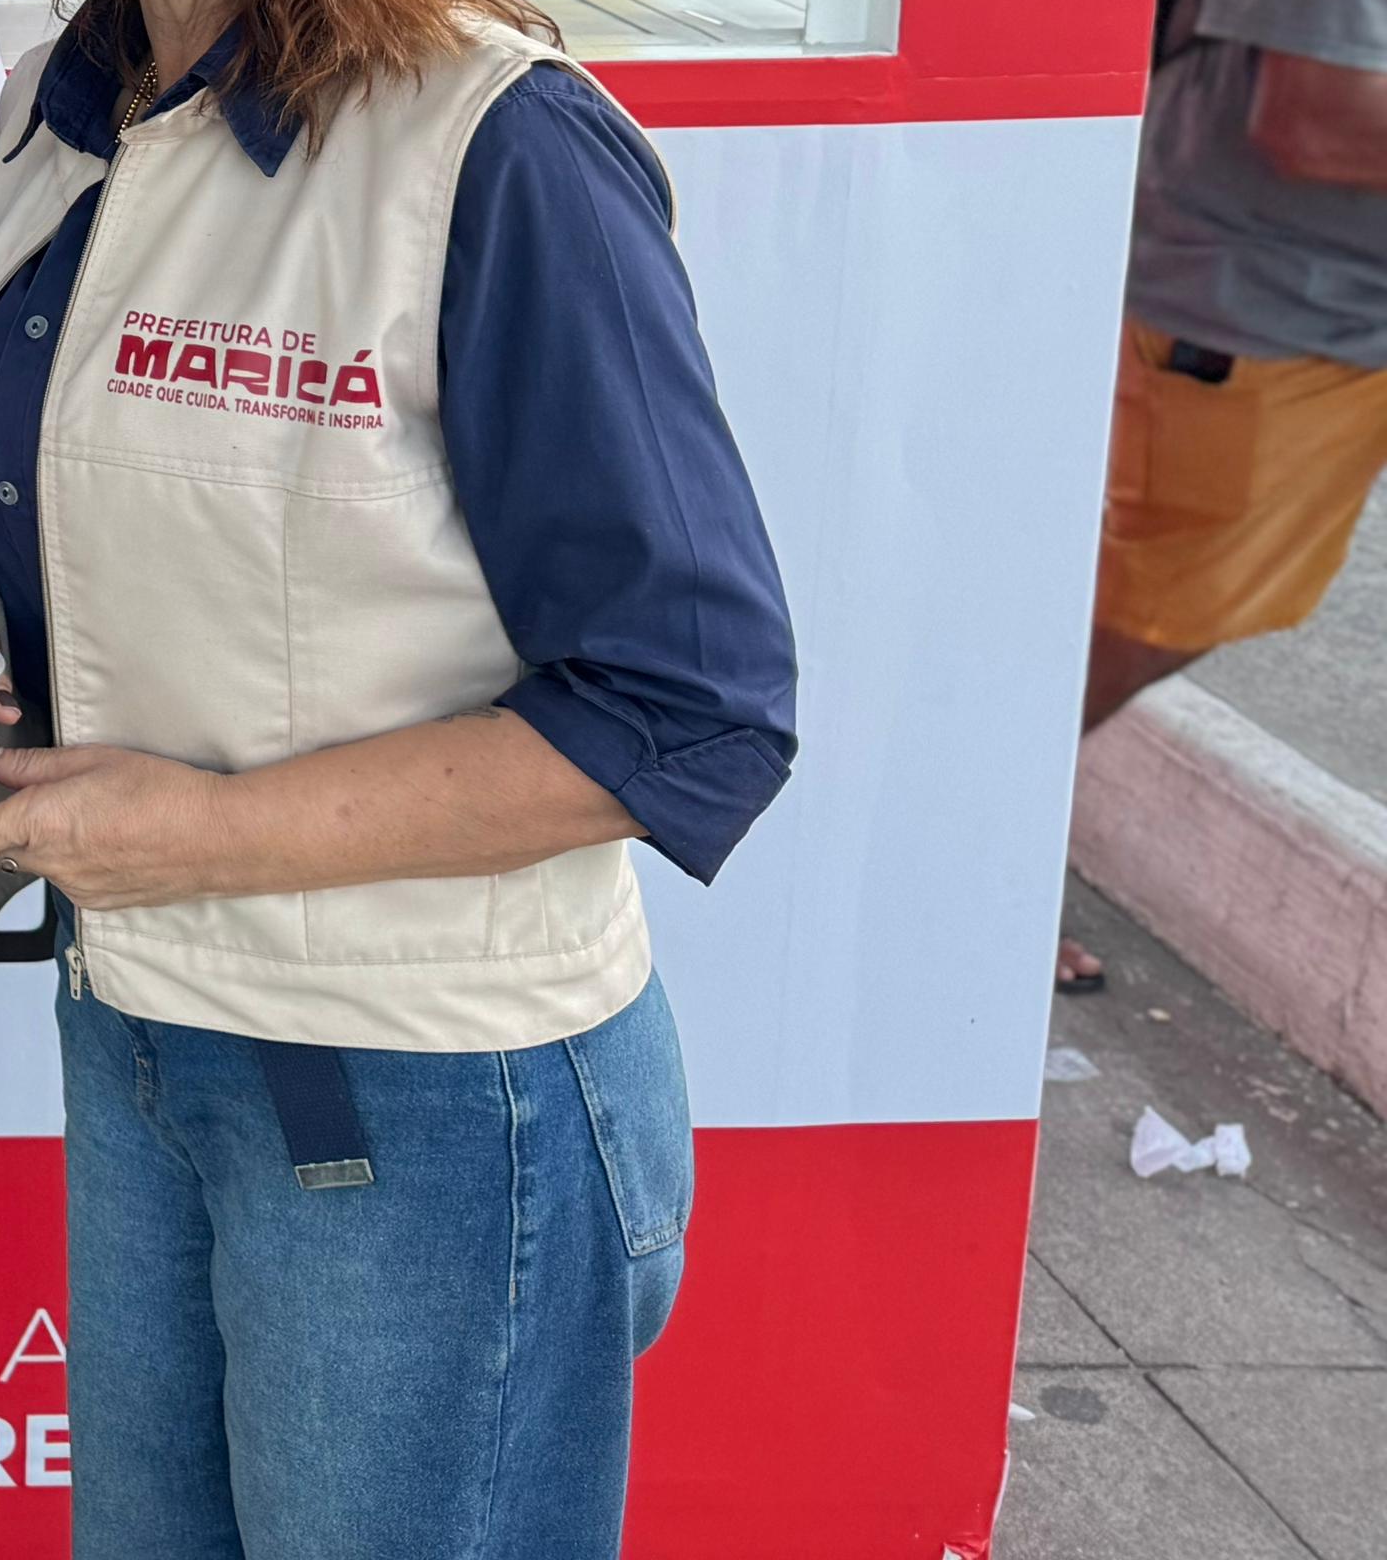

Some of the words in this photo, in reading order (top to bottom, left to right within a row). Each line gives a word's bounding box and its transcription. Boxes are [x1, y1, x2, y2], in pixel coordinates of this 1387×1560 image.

[123, 311, 272, 348] PREFEITURA
[282, 330, 316, 354] DE
[115, 334, 382, 408] MARICÁ
[107, 379, 153, 399] CIDADE
[156, 386, 184, 404] QUE
[235, 398, 316, 425] TRANSFORM
[318, 411, 325, 426] E
